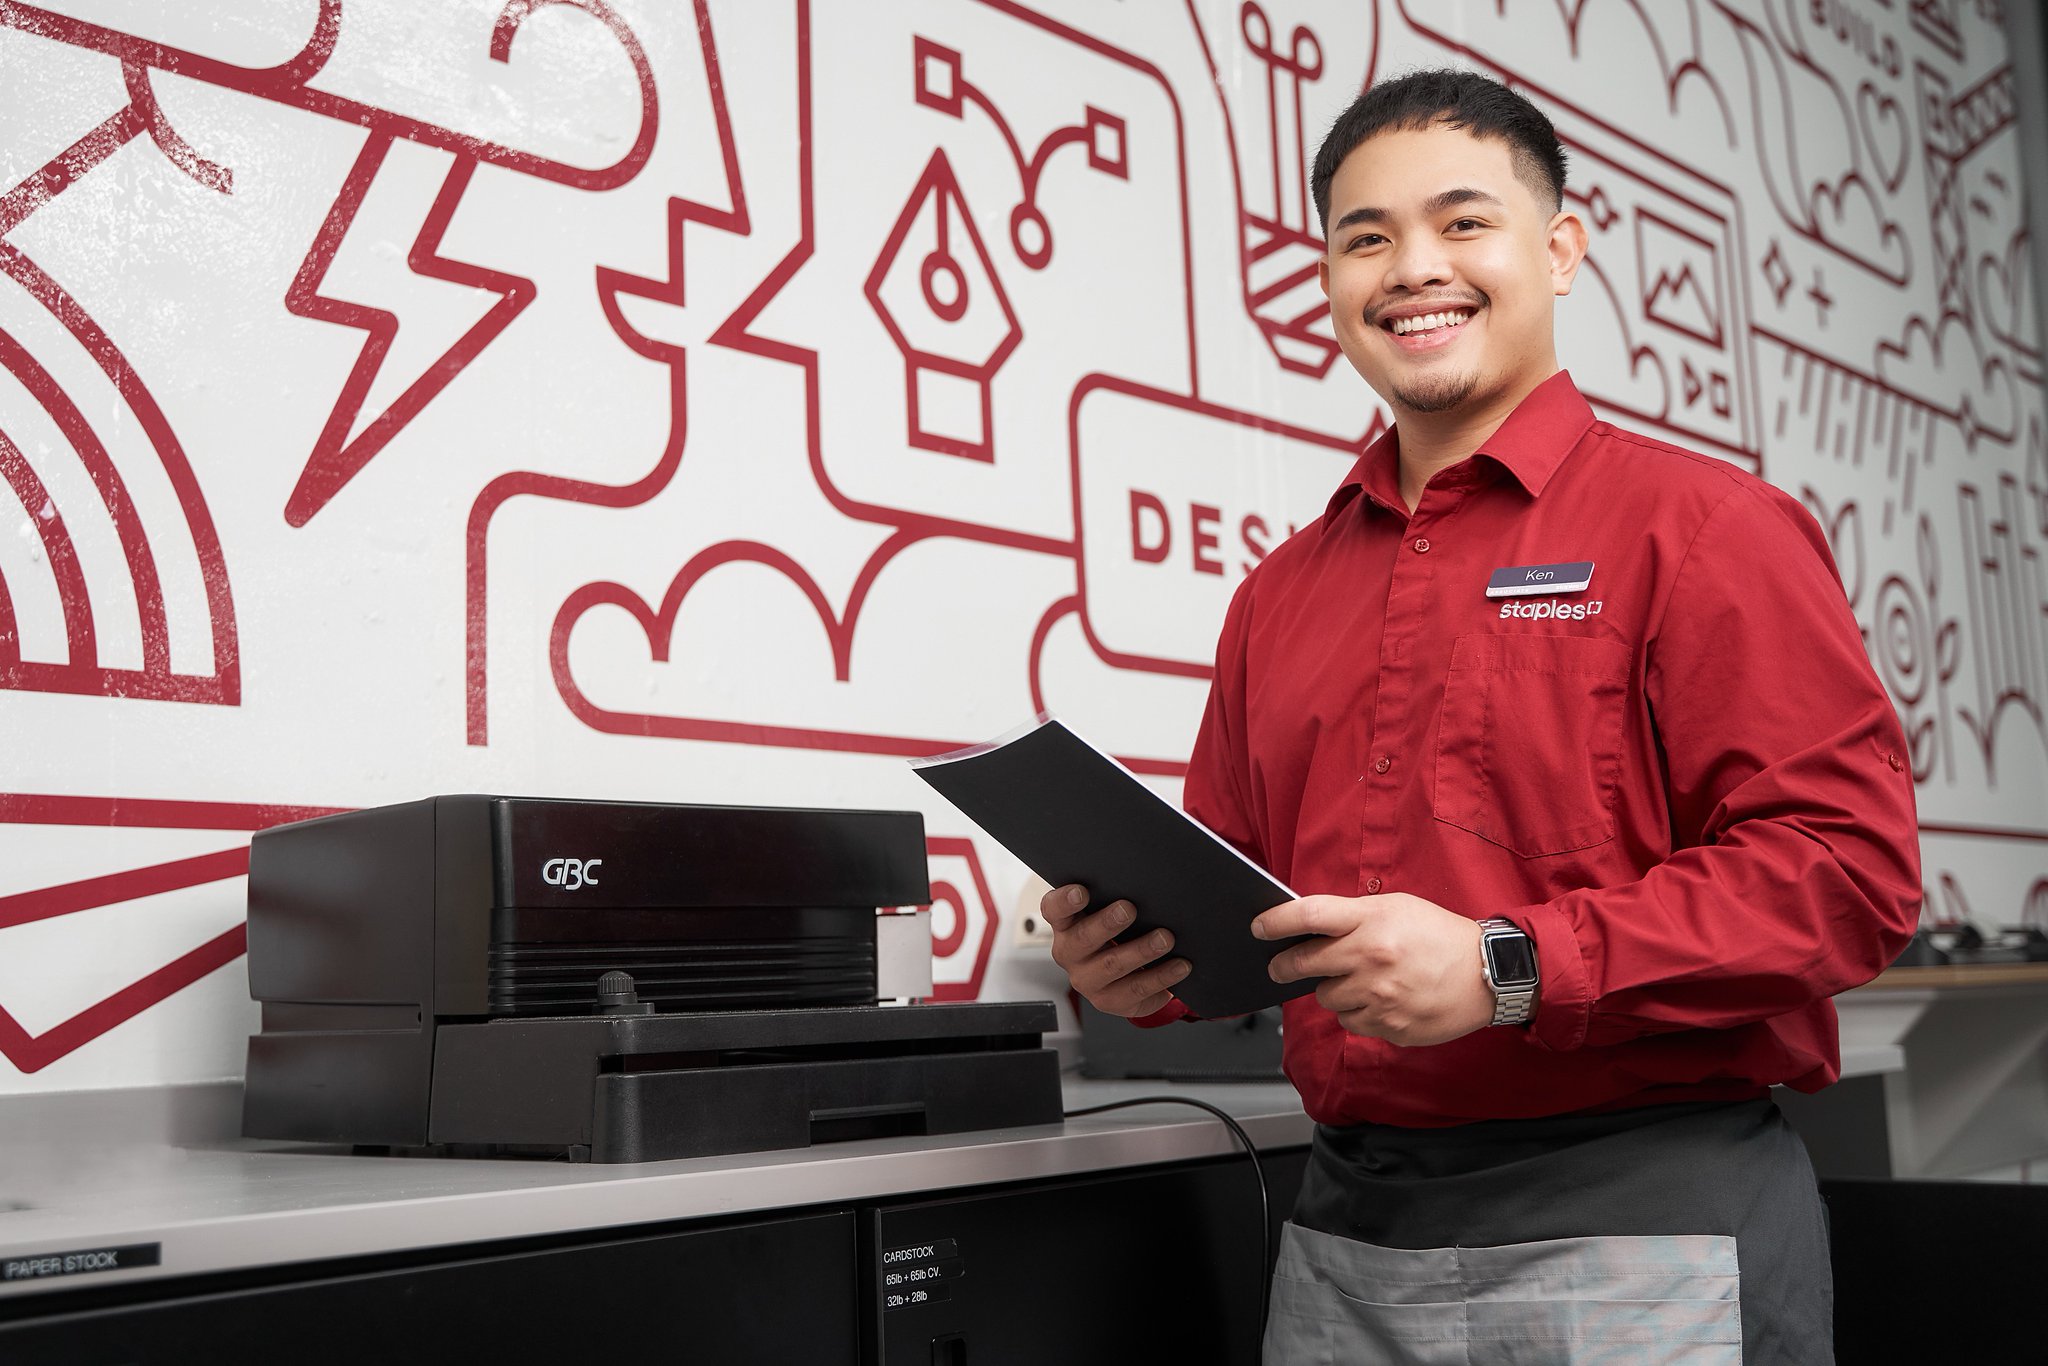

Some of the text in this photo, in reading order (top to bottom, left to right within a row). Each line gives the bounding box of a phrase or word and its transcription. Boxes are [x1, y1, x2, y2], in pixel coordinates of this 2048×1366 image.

[1129, 488, 1299, 577] DES
[1525, 569, 1554, 581] Ken
[1499, 600, 1586, 621] staples
[542, 858, 602, 890] GBC
[883, 1245, 934, 1263] CARDSTOCK
[6, 1251, 118, 1279] PAPER STOCK
[886, 1273, 903, 1286] 65lb
[910, 1269, 927, 1282] 65lb
[927, 1266, 942, 1278] CV.
[887, 1294, 904, 1307] 32lb
[911, 1290, 928, 1303] 28lb
